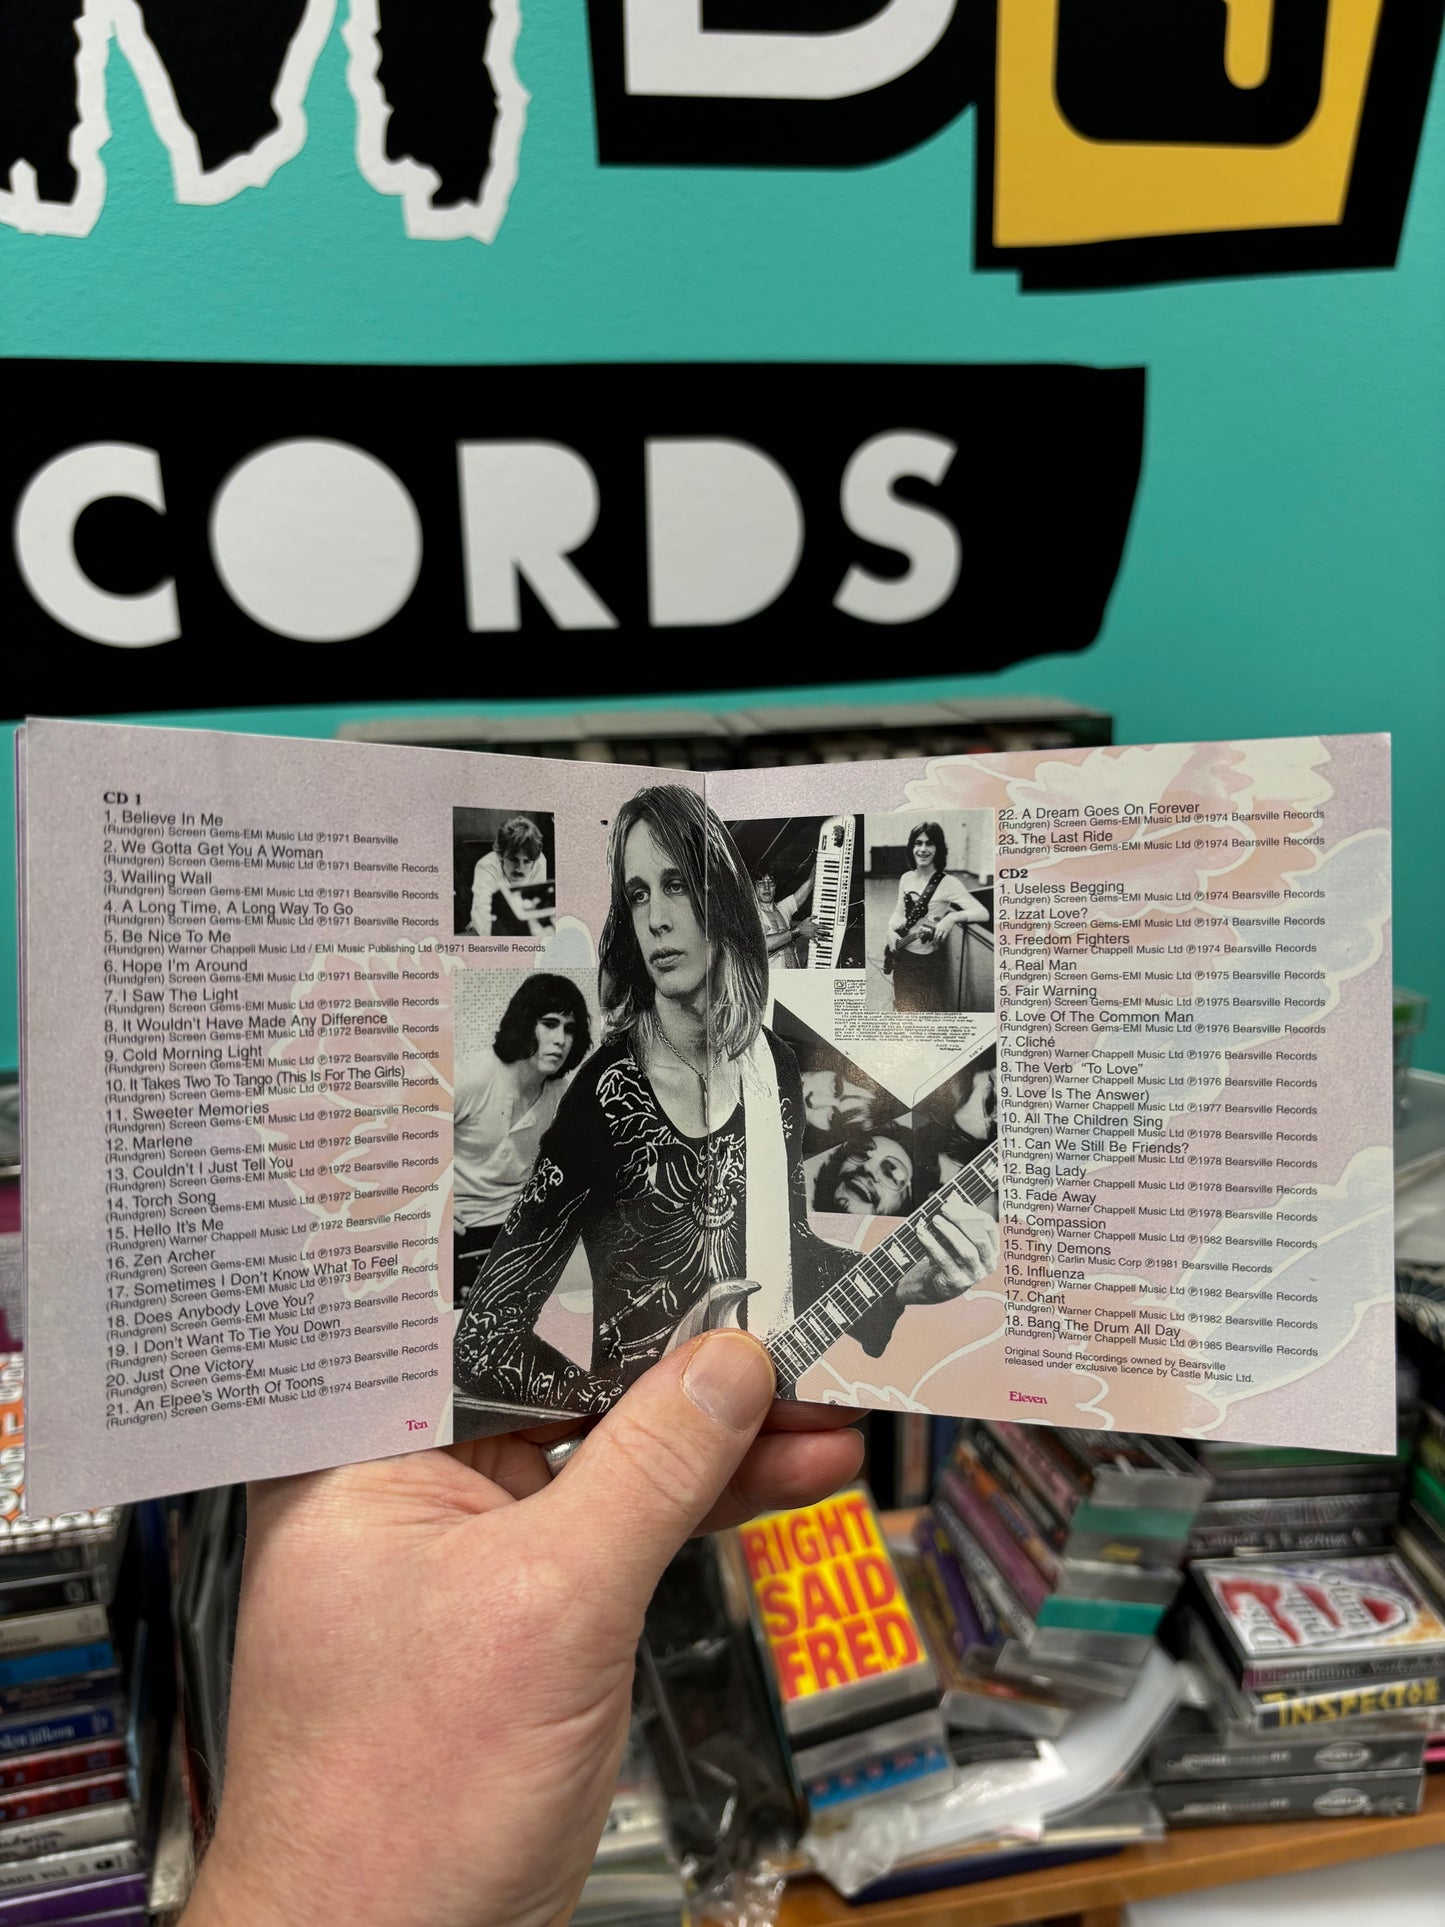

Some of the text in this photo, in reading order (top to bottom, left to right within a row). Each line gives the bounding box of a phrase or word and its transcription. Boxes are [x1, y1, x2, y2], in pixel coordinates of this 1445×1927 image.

[103, 792, 141, 805] CD 1
[104, 812, 223, 826] 1. Believe In Me
[998, 803, 1200, 821] 22. A Dream Goes On Forever
[998, 830, 1113, 845] 23. The Last Ride
[104, 842, 323, 859] 2. We Gotta Get You A Woman
[104, 856, 164, 868] (Rundgren)
[167, 857, 206, 867] Screen
[208, 858, 263, 868] Gems-EMI
[264, 859, 295, 869] Music
[297, 860, 313, 870] Ltd
[353, 861, 398, 872] Bearsville
[401, 862, 439, 872] Records
[104, 872, 211, 887] 3. Wailing Wall
[999, 868, 1028, 879] CD2
[999, 882, 1124, 896] 1. Useless Begging
[998, 932, 1130, 947] 3. Freedom Fighters
[104, 961, 117, 973] 6.
[122, 961, 162, 975] Hope
[194, 960, 247, 972] Around
[999, 985, 1097, 999] 5. Fair Warning
[1000, 997, 1052, 1009] (Rundgren)
[1054, 997, 1088, 1006] Screen
[1091, 997, 1141, 1006] Gems-EMI
[1145, 997, 1173, 1006] Music
[1176, 997, 1192, 1006] Ltd
[1232, 997, 1281, 1006] Bearsville
[1283, 997, 1326, 1006] Records
[104, 1021, 117, 1033] 8.
[122, 1020, 131, 1032] It
[205, 1018, 243, 1030] Have
[248, 1016, 286, 1028] Made
[290, 1015, 316, 1029] Any
[321, 1013, 387, 1026] Difference
[999, 1010, 1194, 1023] 6. Love Of The Common Man
[104, 1046, 262, 1062] 9. Cold Morning Light
[1000, 1061, 1012, 1073] 8.
[1015, 1061, 1040, 1073] The
[1043, 1062, 1073, 1074] Verb
[1001, 1112, 1163, 1130] 10. All The Children Sing
[106, 1136, 192, 1150] 12. Marlene
[1002, 1138, 1189, 1154] 11. Can We Still Be Friends?
[106, 1168, 127, 1181] 13.
[198, 1162, 202, 1174] I
[207, 1160, 238, 1174] Just
[242, 1158, 265, 1171] Tell
[268, 1157, 293, 1169] You
[1003, 1213, 1106, 1230] 14. Compassion
[1003, 1238, 1111, 1255] 15. Tiny Demons
[106, 1249, 216, 1269] 16. Zen Archer
[107, 1286, 128, 1298] 17.
[133, 1278, 216, 1296] Sometimes
[221, 1274, 225, 1286] I
[272, 1268, 309, 1280] Know
[313, 1261, 347, 1275] What
[351, 1259, 366, 1271] To
[370, 1255, 398, 1269] Feel
[1004, 1264, 1085, 1279] 16. Influenza
[1004, 1315, 1181, 1339] 18. Bang The Drum All Day
[1004, 1345, 1226, 1370] Original Sound Recordings owned by Bearsville
[105, 1360, 254, 1387] 20. Just One Victory
[1004, 1356, 1254, 1383] released under exclusive licence by Castle Music Ltd.
[105, 1403, 129, 1416] 21.
[133, 1400, 154, 1412] An
[216, 1384, 259, 1400] Worth
[264, 1381, 281, 1394] Of
[285, 1377, 324, 1391] Toons
[1008, 1391, 1048, 1404] Eleven
[405, 1420, 428, 1431] Ten
[740, 1496, 875, 1582] RIGHT
[760, 1554, 897, 1637] SAID
[773, 1610, 920, 1703] FRED
[1274, 1676, 1440, 1728] INSPECTOR
